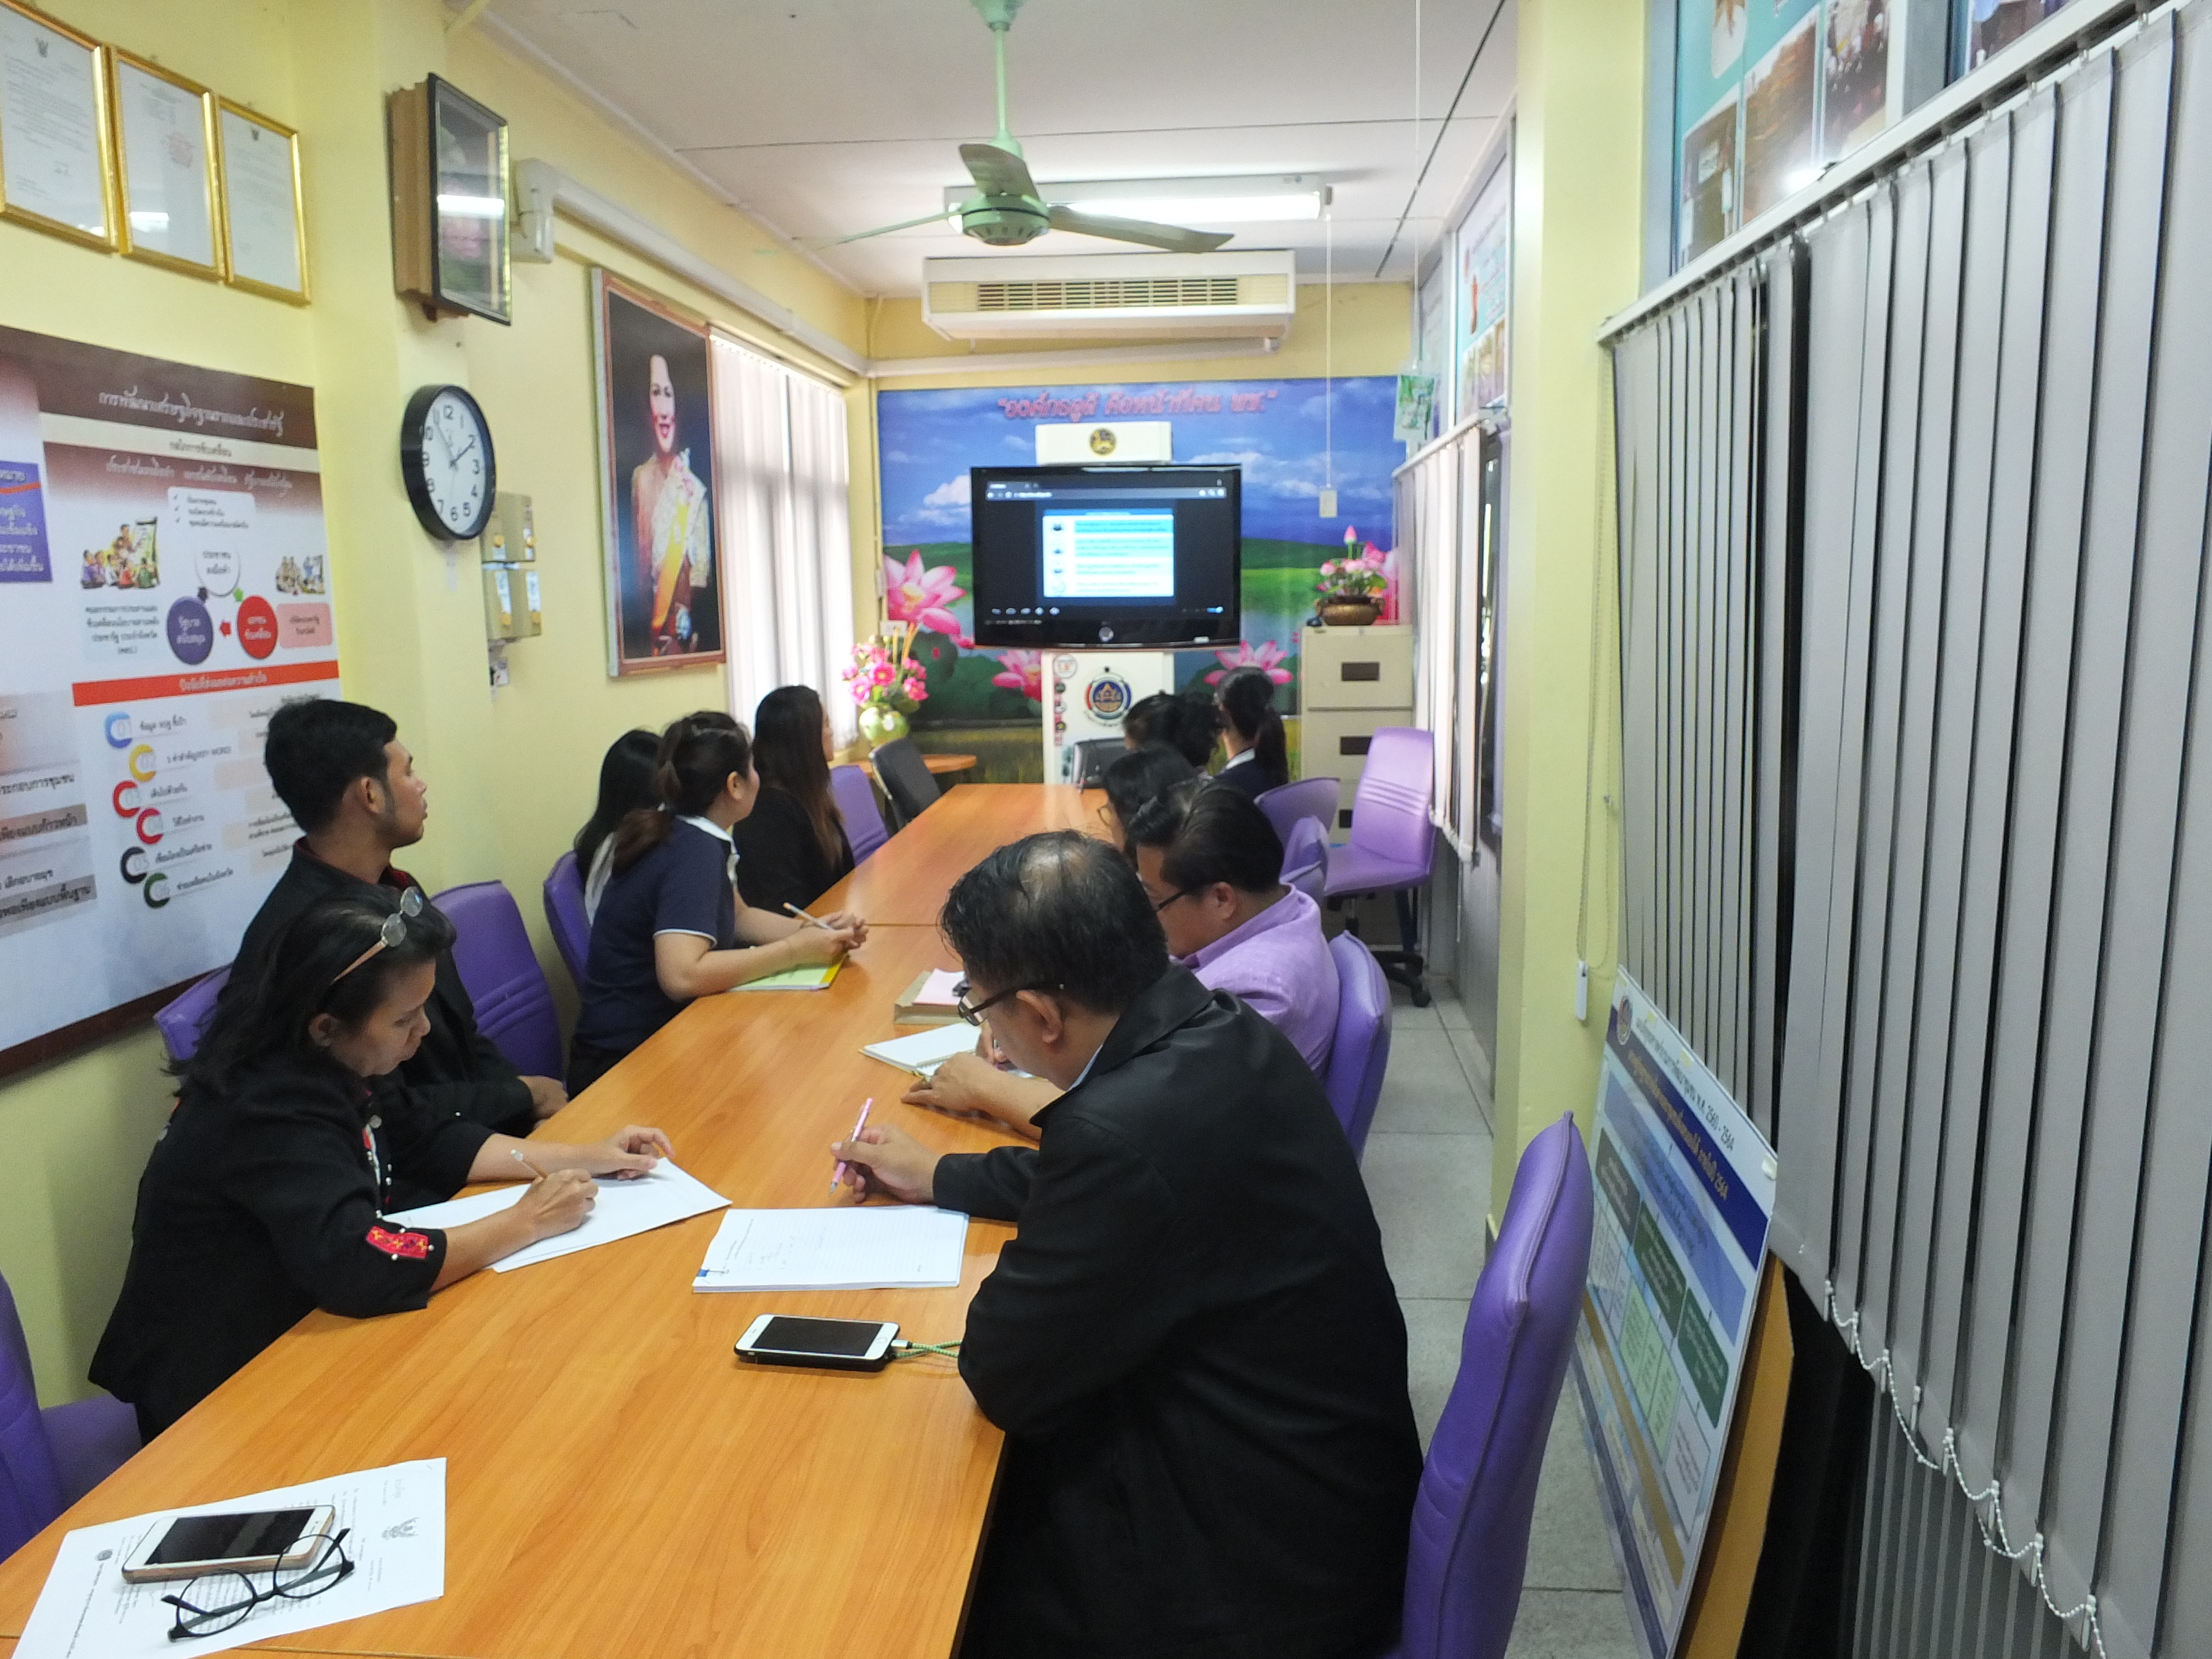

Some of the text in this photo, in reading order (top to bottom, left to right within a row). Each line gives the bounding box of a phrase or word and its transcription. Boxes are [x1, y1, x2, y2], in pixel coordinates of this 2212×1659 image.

[472, 459, 481, 475] 3
[470, 483, 478, 497] 4
[437, 498, 445, 513] 7
[462, 501, 471, 517] 5
[450, 506, 459, 522] 6
[0, 774, 75, 795] ระกอบการชุมชน
